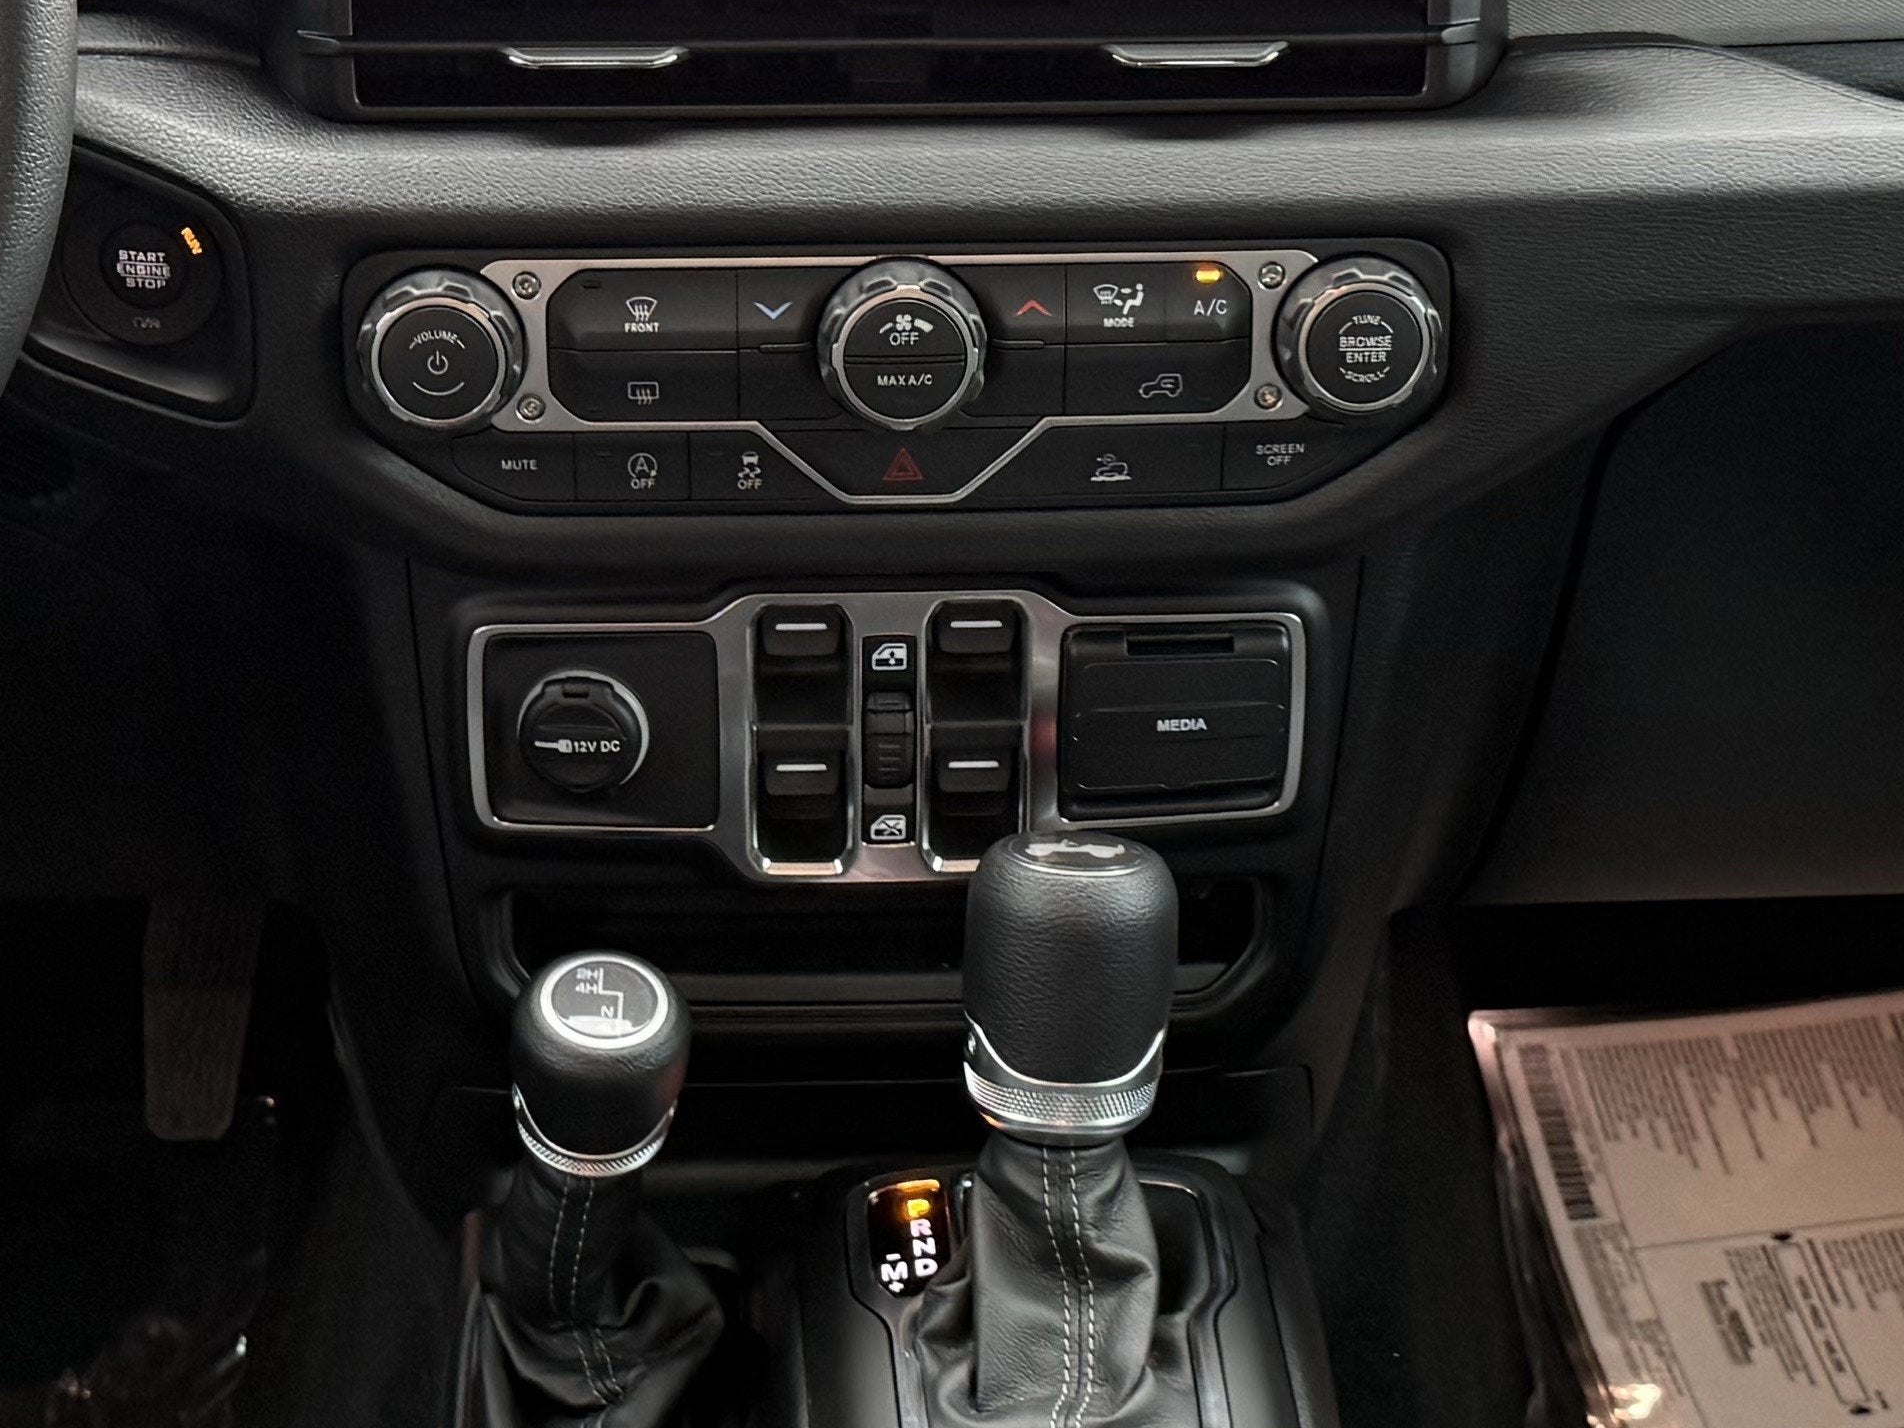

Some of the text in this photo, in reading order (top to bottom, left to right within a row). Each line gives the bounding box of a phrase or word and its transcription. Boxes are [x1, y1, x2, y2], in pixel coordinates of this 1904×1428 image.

[118, 249, 166, 262] START
[116, 262, 171, 277] ENGINE
[125, 277, 167, 289] STOP
[1193, 299, 1228, 317] A/C
[1103, 317, 1135, 329] MODE
[1351, 314, 1381, 326] TUNE
[624, 322, 659, 334] FRONT
[414, 329, 460, 345] VOLUME
[889, 332, 919, 346] OFF
[1338, 336, 1393, 348] BROWSE
[1345, 351, 1387, 364] ENTER
[877, 372, 933, 387] MAX A/C
[1344, 370, 1385, 384] SCROLL
[1255, 443, 1306, 456] SCREEN
[501, 458, 538, 472] MUTE
[1266, 455, 1292, 466] OFF
[630, 478, 656, 490] OFF
[737, 478, 763, 491] OFF
[1156, 715, 1208, 733] MEDIA
[574, 740, 621, 753] 12V DC
[601, 1005, 614, 1018] N
[910, 1218, 933, 1237] R
[912, 1236, 936, 1257] N
[880, 1261, 909, 1282] M
[914, 1257, 938, 1277] D
